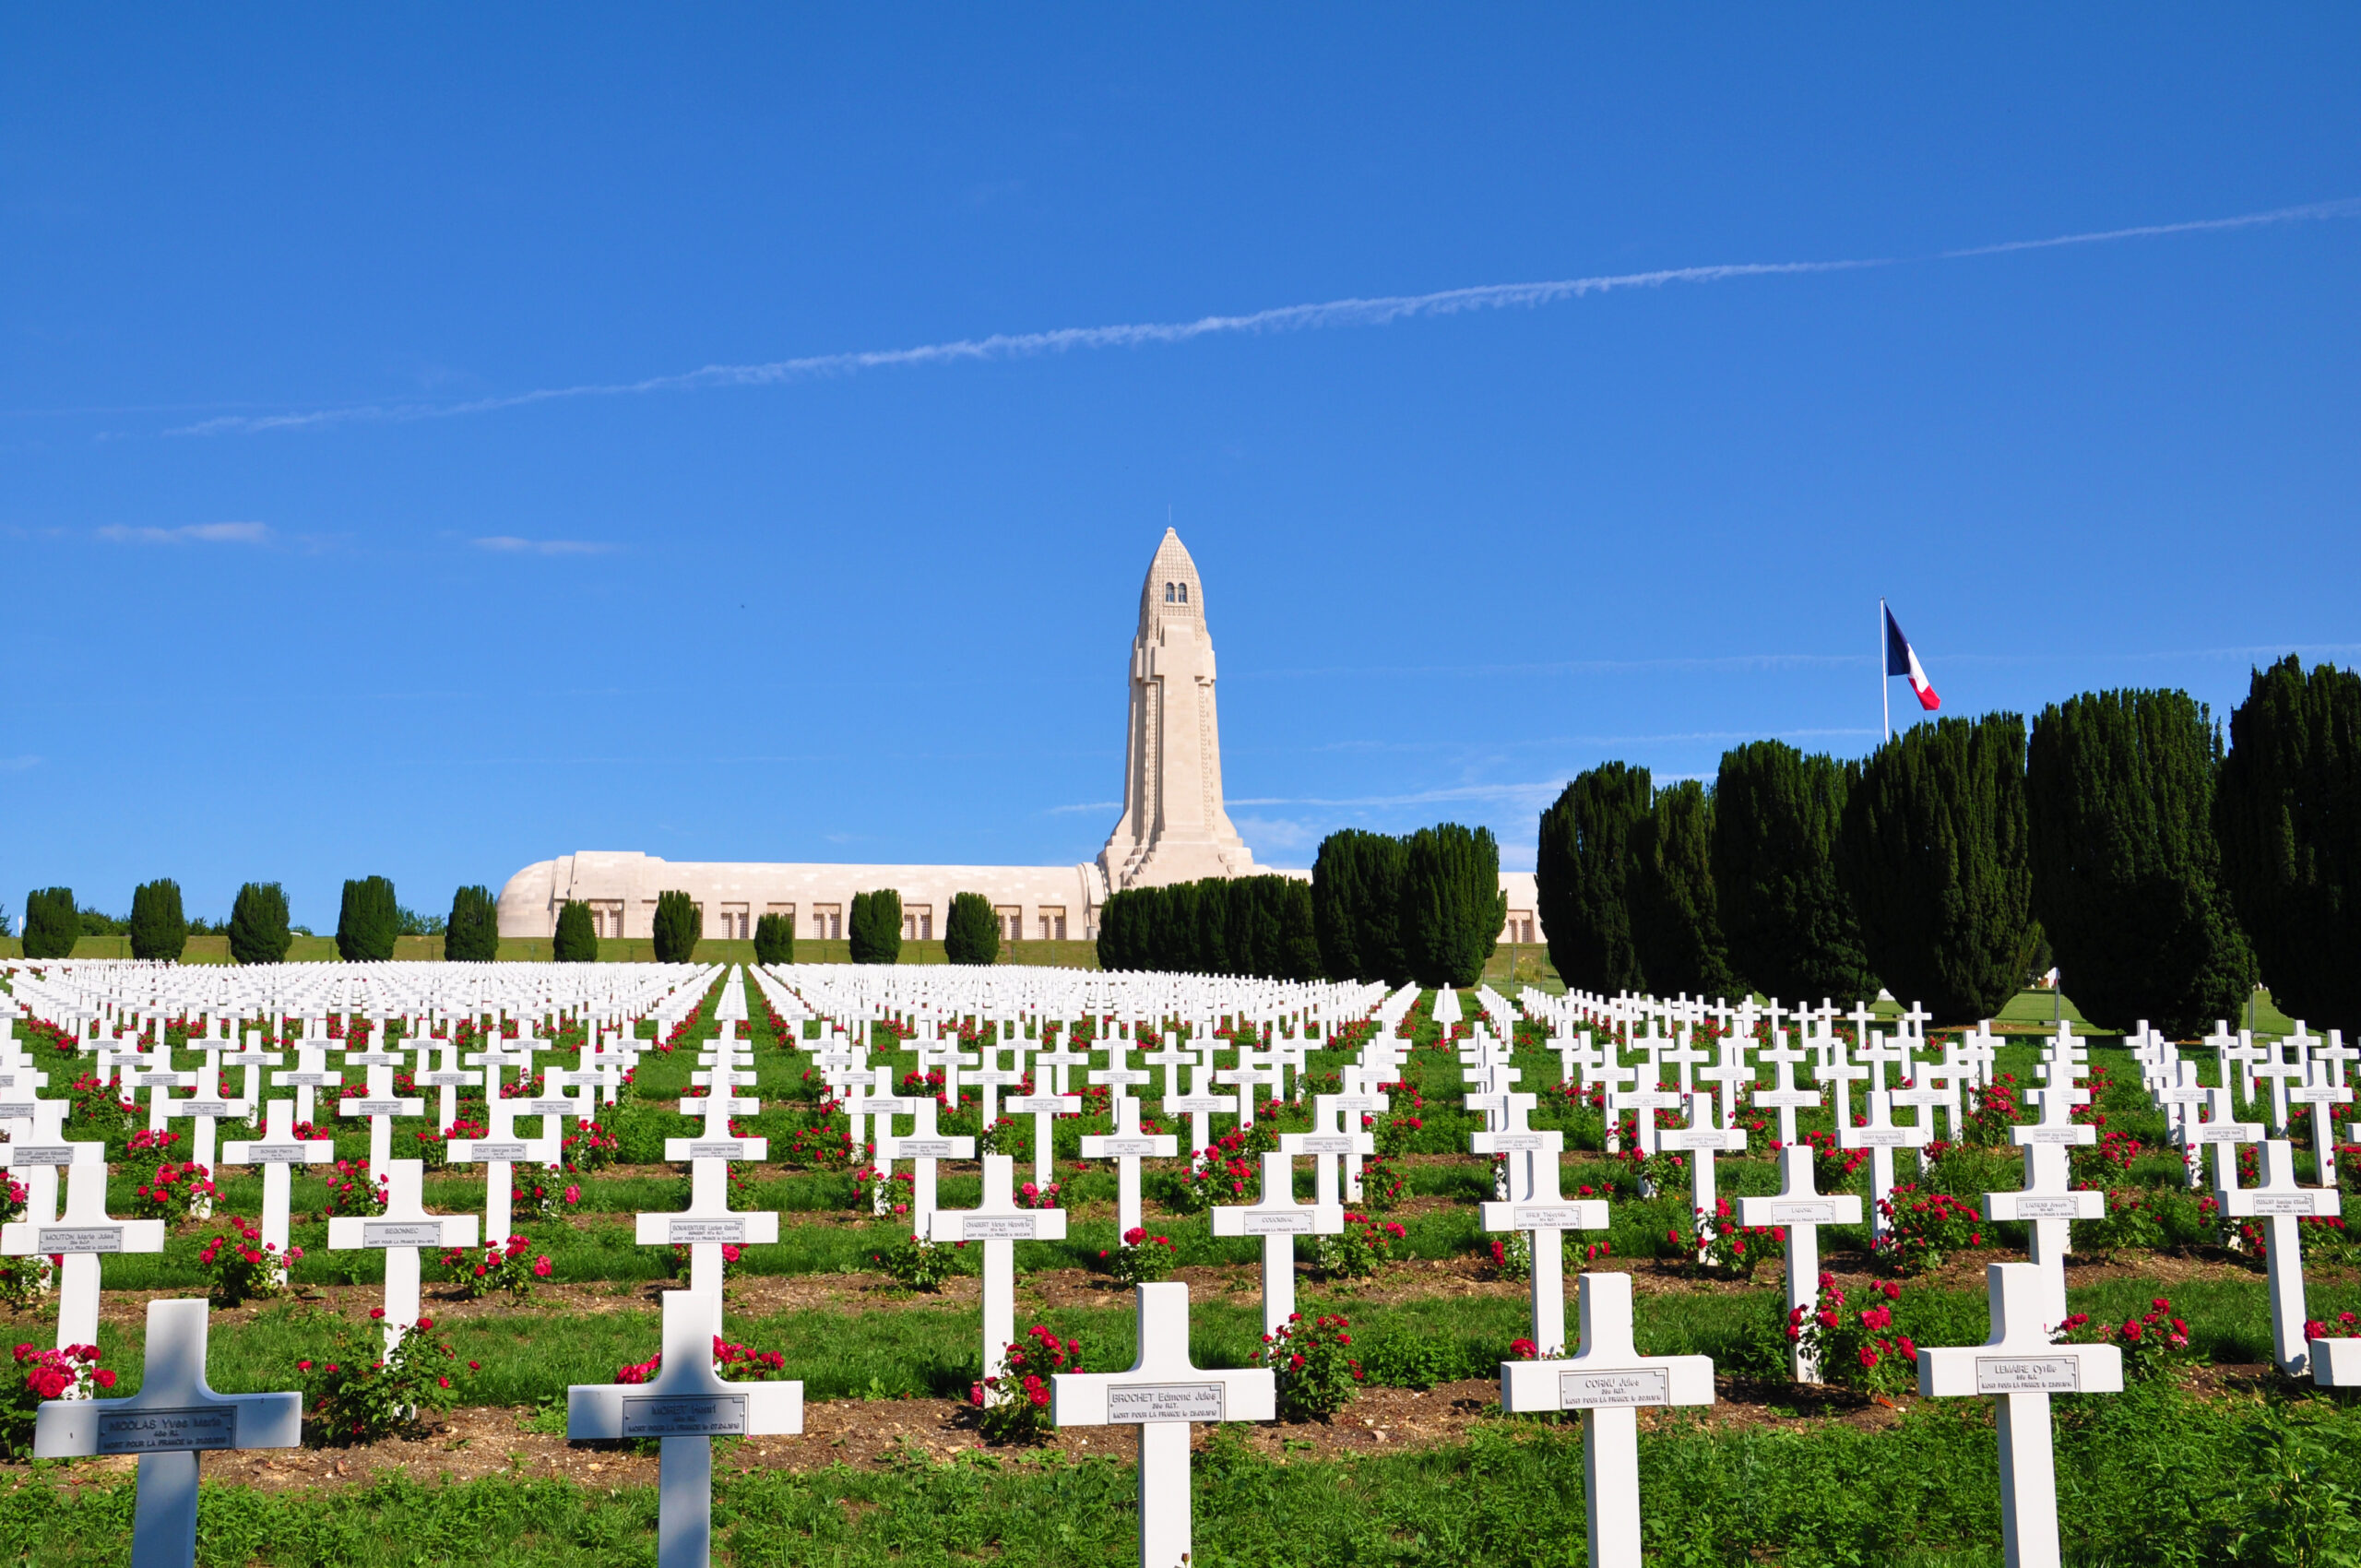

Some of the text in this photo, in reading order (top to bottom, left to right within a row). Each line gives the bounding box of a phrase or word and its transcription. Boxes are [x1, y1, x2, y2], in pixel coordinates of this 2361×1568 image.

[1995, 1365, 2058, 1375] LEMAIRE Cyrille
[1585, 1378, 1640, 1388] CORNU Jules
[1111, 1392, 1216, 1403] BROCHET Edmond Jules
[651, 1404, 717, 1415] MORET Henri
[109, 1418, 221, 1431] NICOLAS Yves Marie
[104, 1441, 124, 1449] MORT
[126, 1440, 144, 1448] POUR
[158, 1438, 184, 1446] FRANCE
